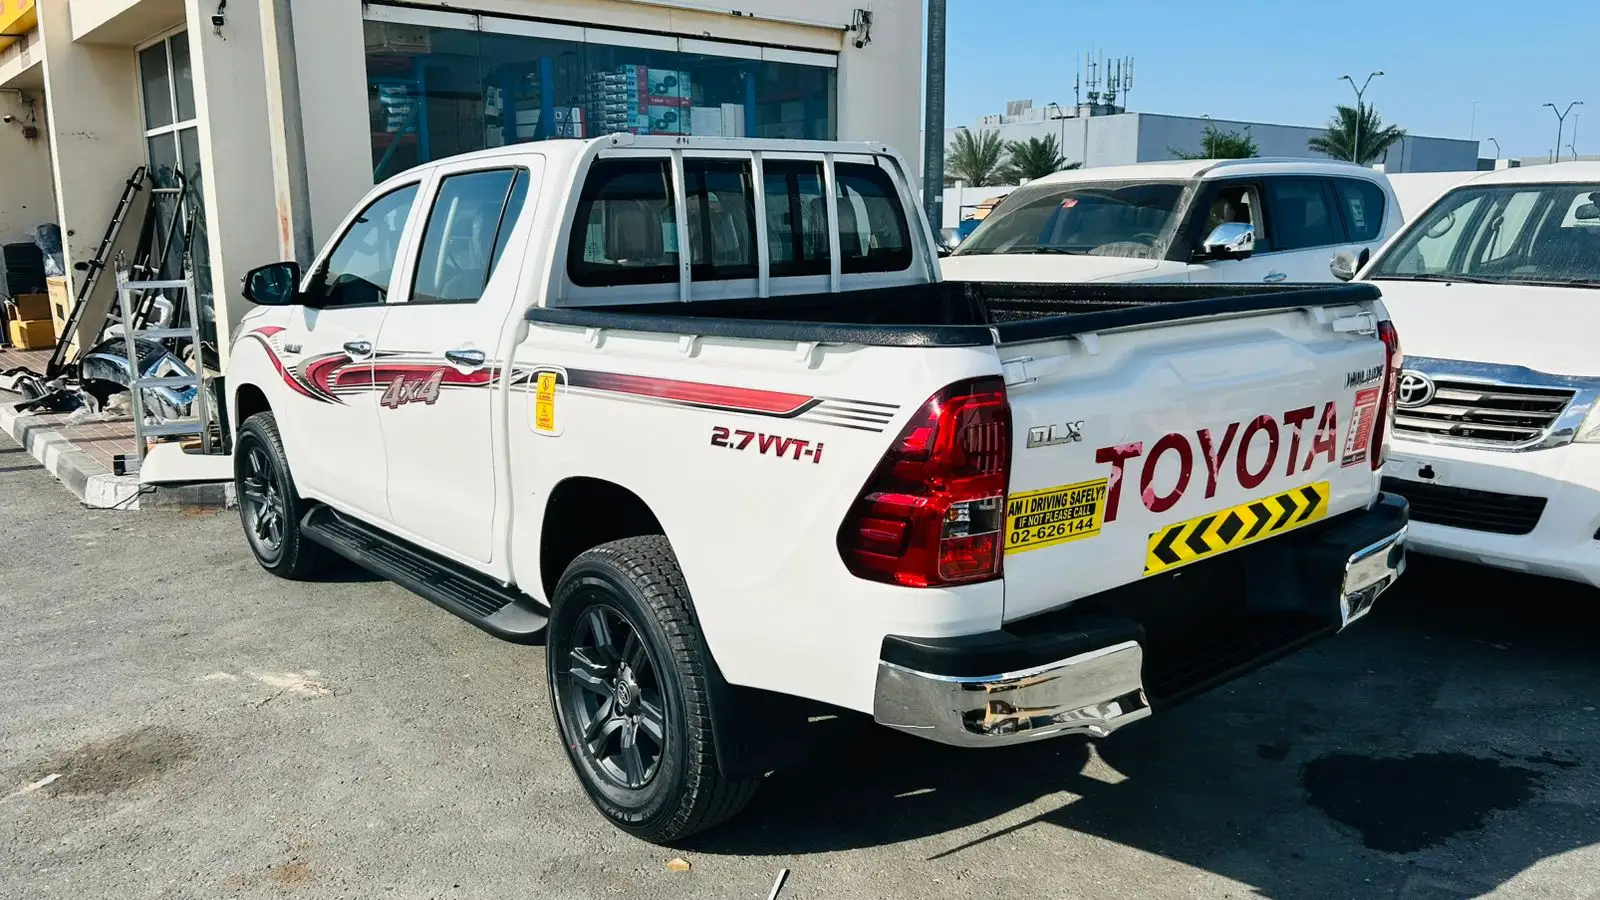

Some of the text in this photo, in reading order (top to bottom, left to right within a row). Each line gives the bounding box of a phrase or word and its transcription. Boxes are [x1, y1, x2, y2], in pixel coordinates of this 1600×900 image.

[380, 367, 446, 409] 4x4
[1026, 420, 1084, 449] DLX
[1095, 401, 1337, 523] TOYOTA
[1008, 501, 1023, 517] AM
[1030, 493, 1067, 513] DRIVING
[1069, 485, 1106, 505] SAFELY?
[1010, 517, 1094, 545] 02-626144
[1018, 506, 1091, 528] IF NOT PLEASE CALL
